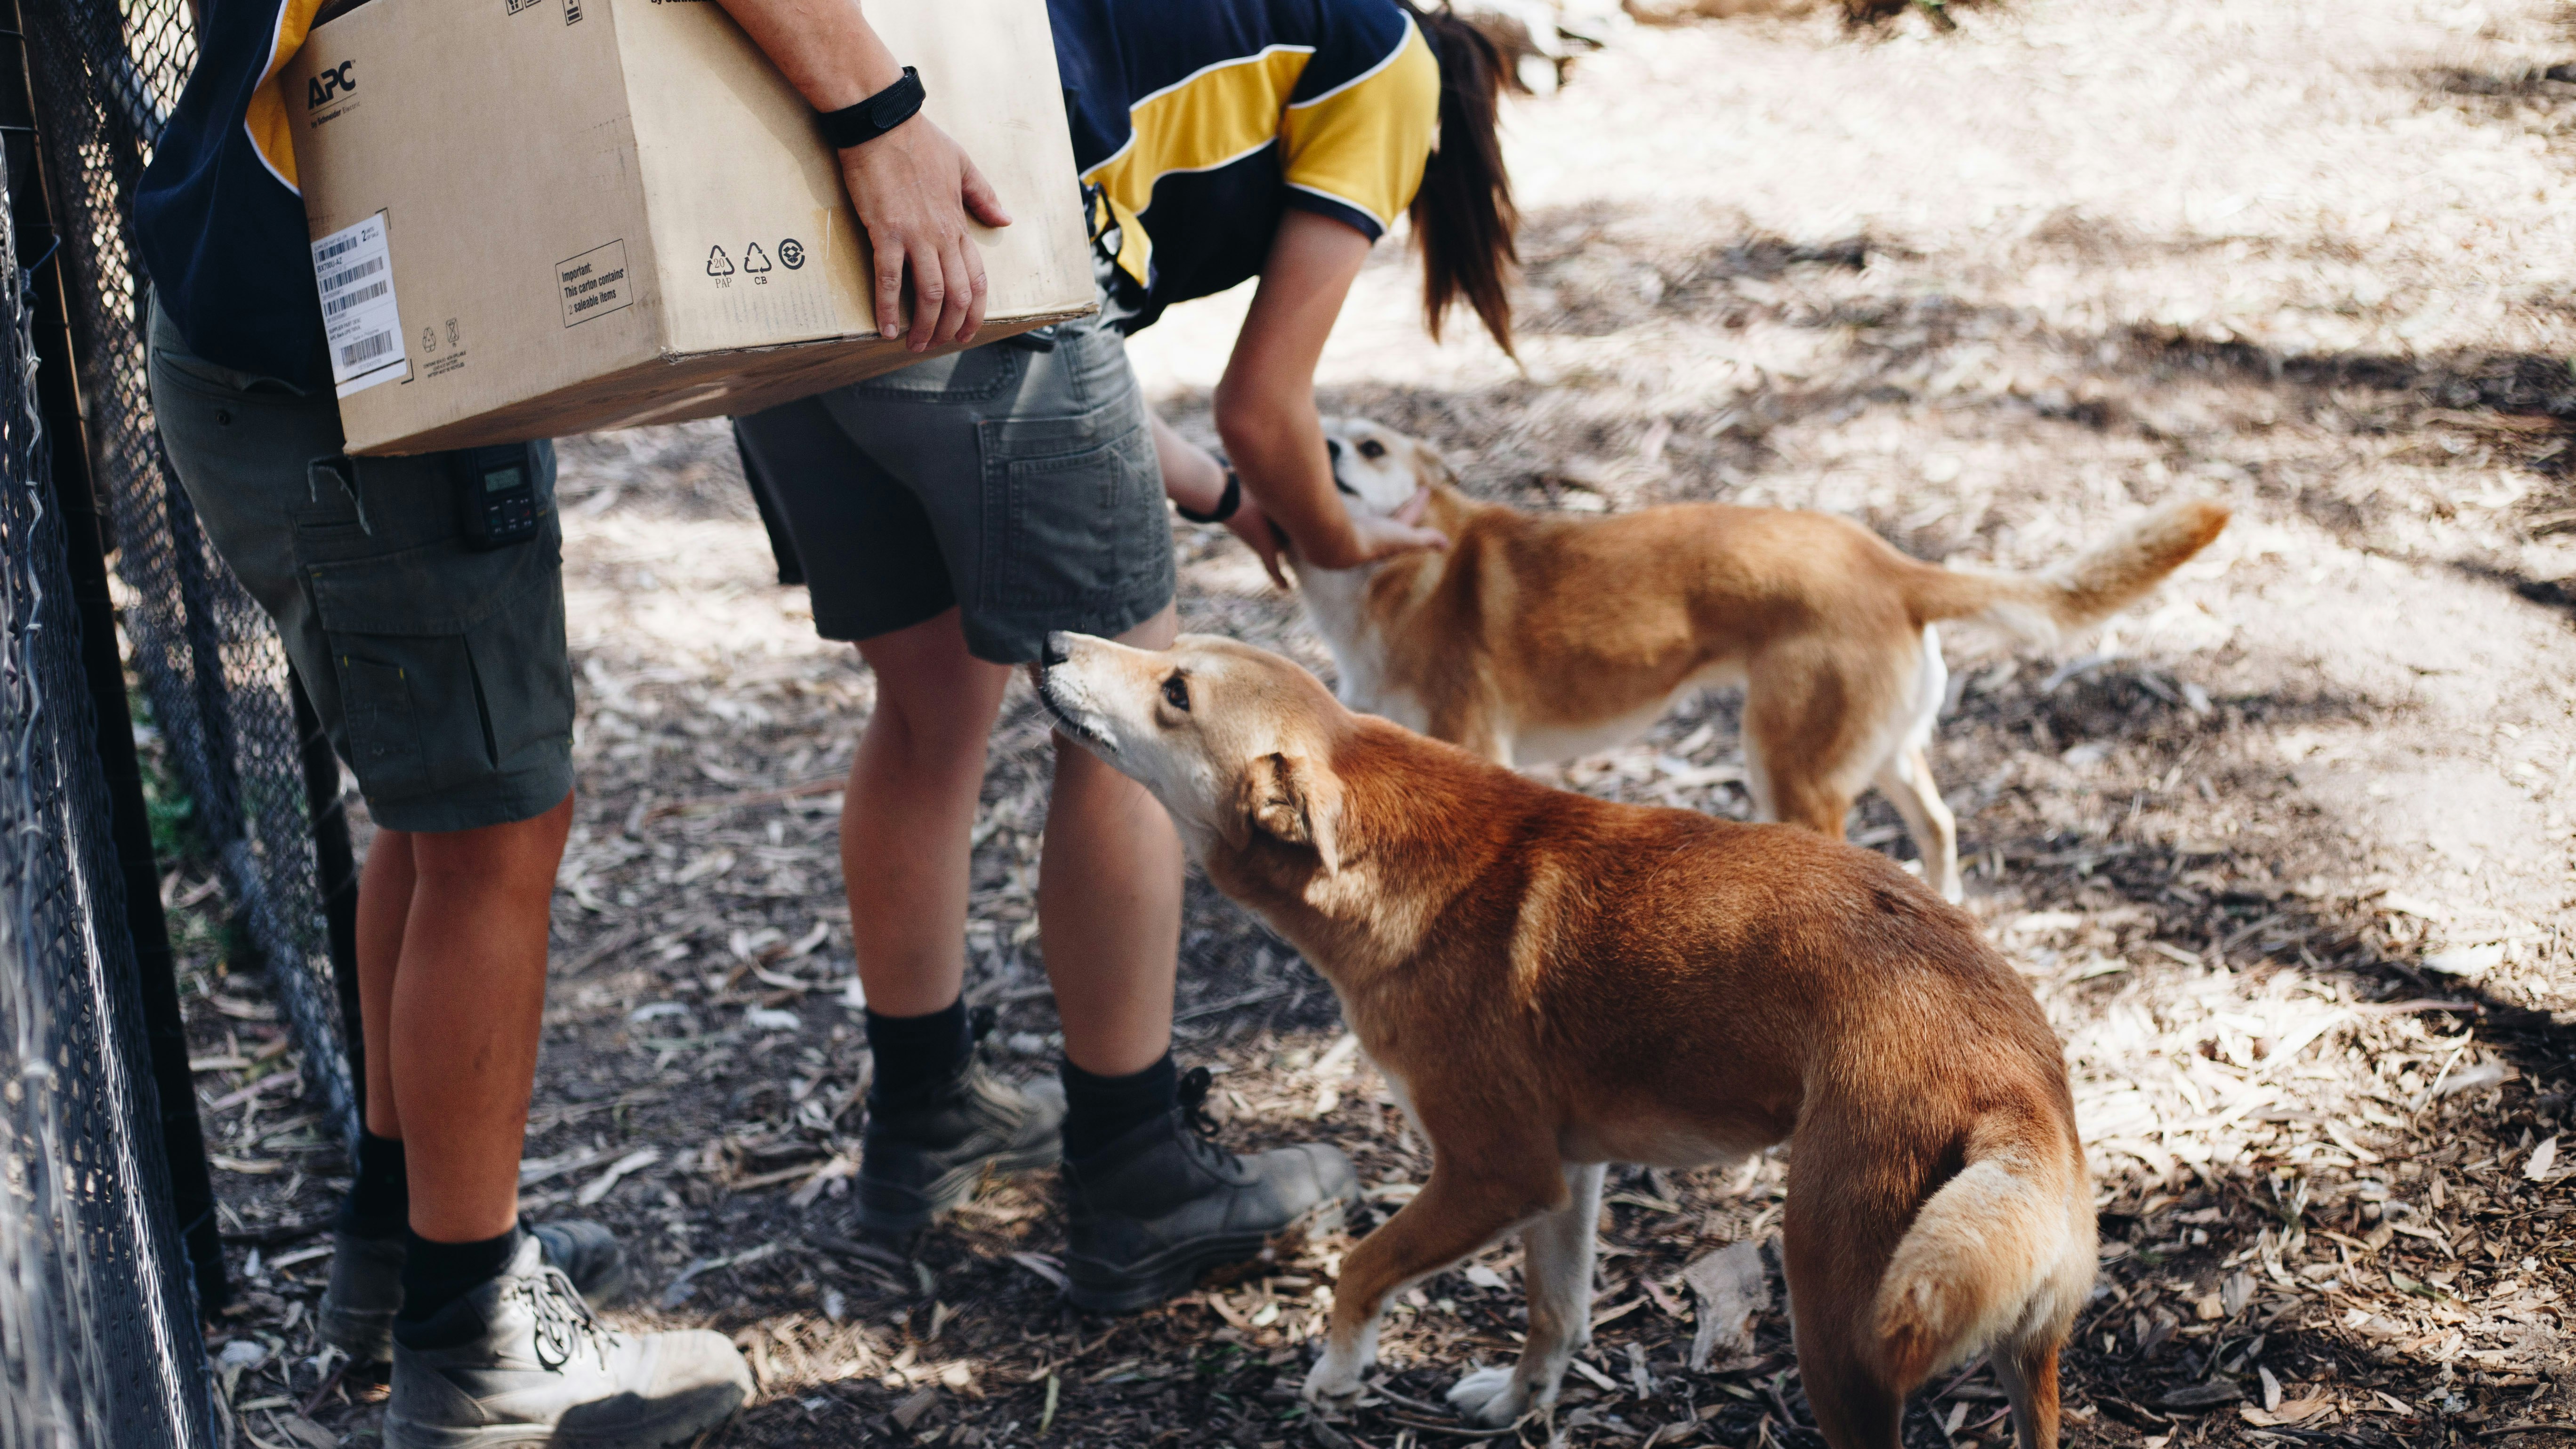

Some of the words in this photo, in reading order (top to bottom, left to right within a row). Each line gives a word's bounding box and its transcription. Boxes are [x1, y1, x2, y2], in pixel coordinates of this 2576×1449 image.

[308, 60, 356, 110] APC
[362, 230, 366, 242] 2
[317, 257, 343, 273] BX700U-AZ
[713, 258, 725, 268] 20
[562, 262, 593, 282] Important:
[564, 285, 578, 298] This
[579, 279, 597, 294] carton
[598, 268, 624, 286] contains
[715, 277, 732, 289] PAP
[754, 276, 767, 285] CB
[568, 304, 573, 315] 2
[574, 295, 599, 313] saleable
[599, 289, 616, 303] items
